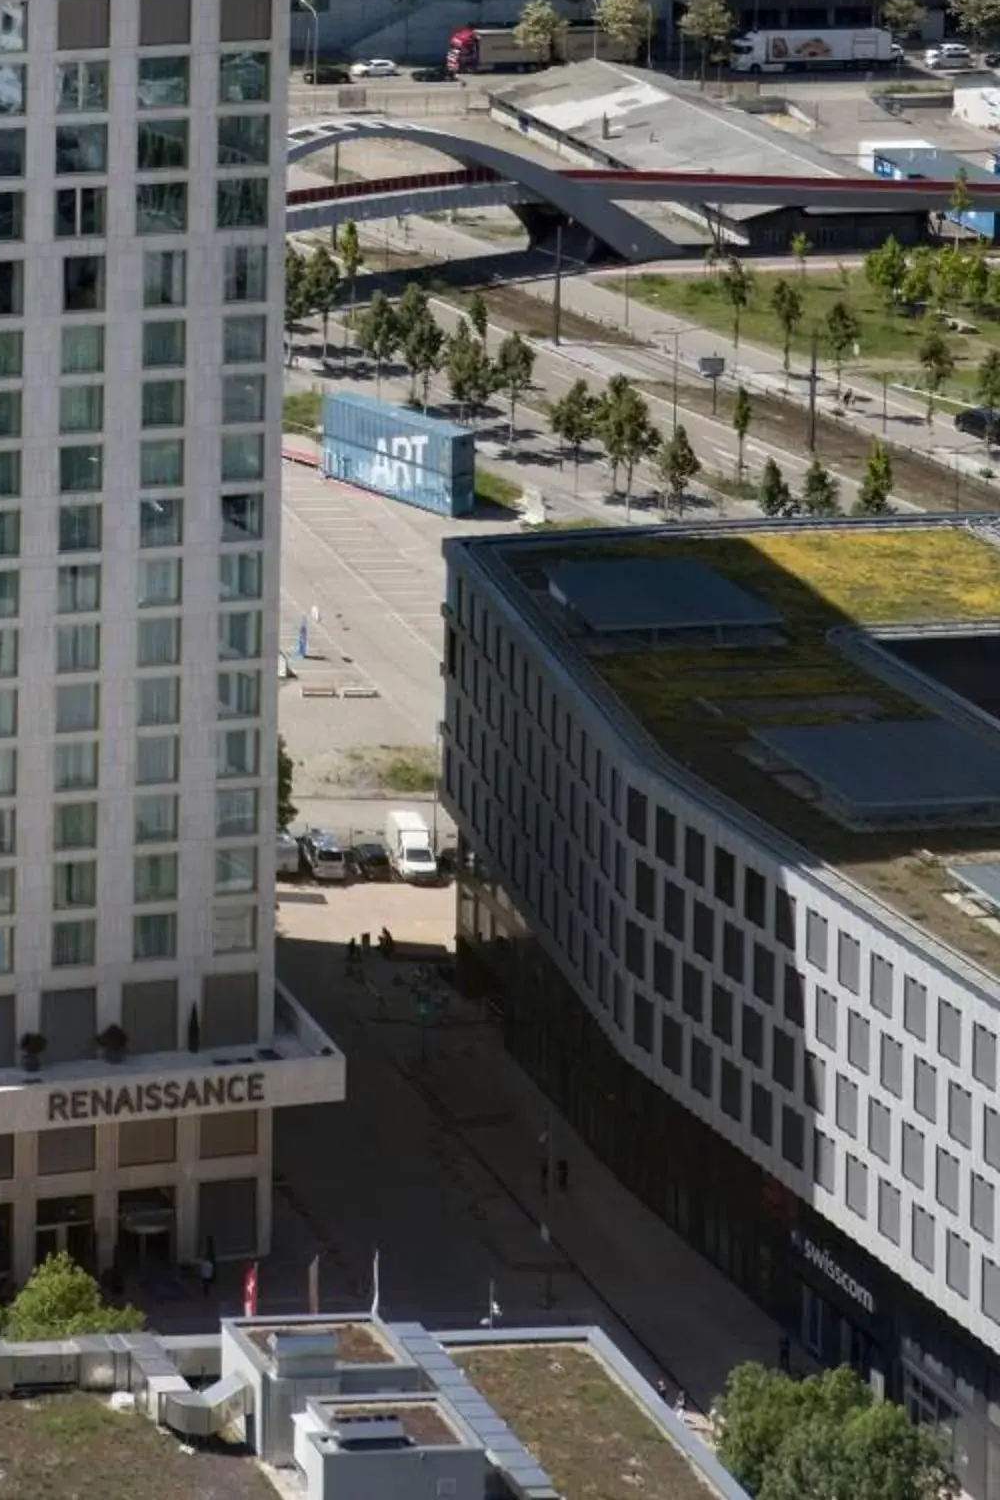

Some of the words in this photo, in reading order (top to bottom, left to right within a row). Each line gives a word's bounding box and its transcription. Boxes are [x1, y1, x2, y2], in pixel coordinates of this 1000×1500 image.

[370, 436, 428, 491] ART
[49, 1073, 265, 1121] RENAISSANCE
[804, 1239, 874, 1312] swisscom
